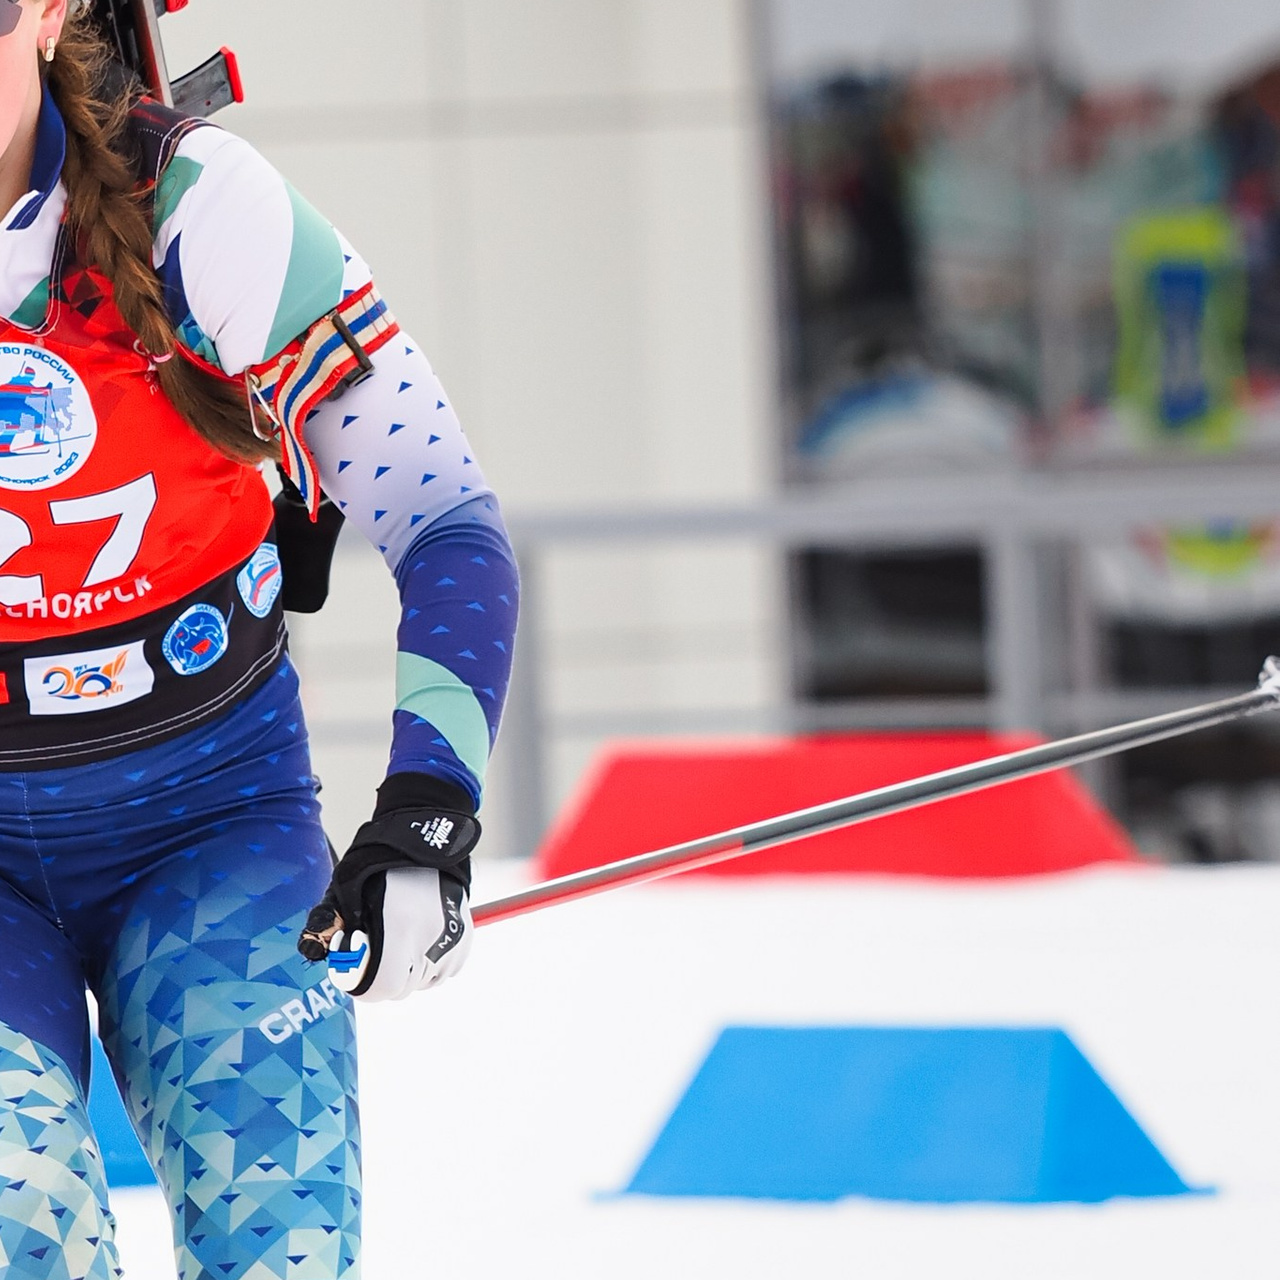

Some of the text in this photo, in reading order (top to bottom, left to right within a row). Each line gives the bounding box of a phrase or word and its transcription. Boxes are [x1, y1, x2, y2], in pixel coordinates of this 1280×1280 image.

[23, 348, 76, 384] РОССИИ
[53, 451, 80, 476] 2023
[258, 977, 346, 1045] CRAF
